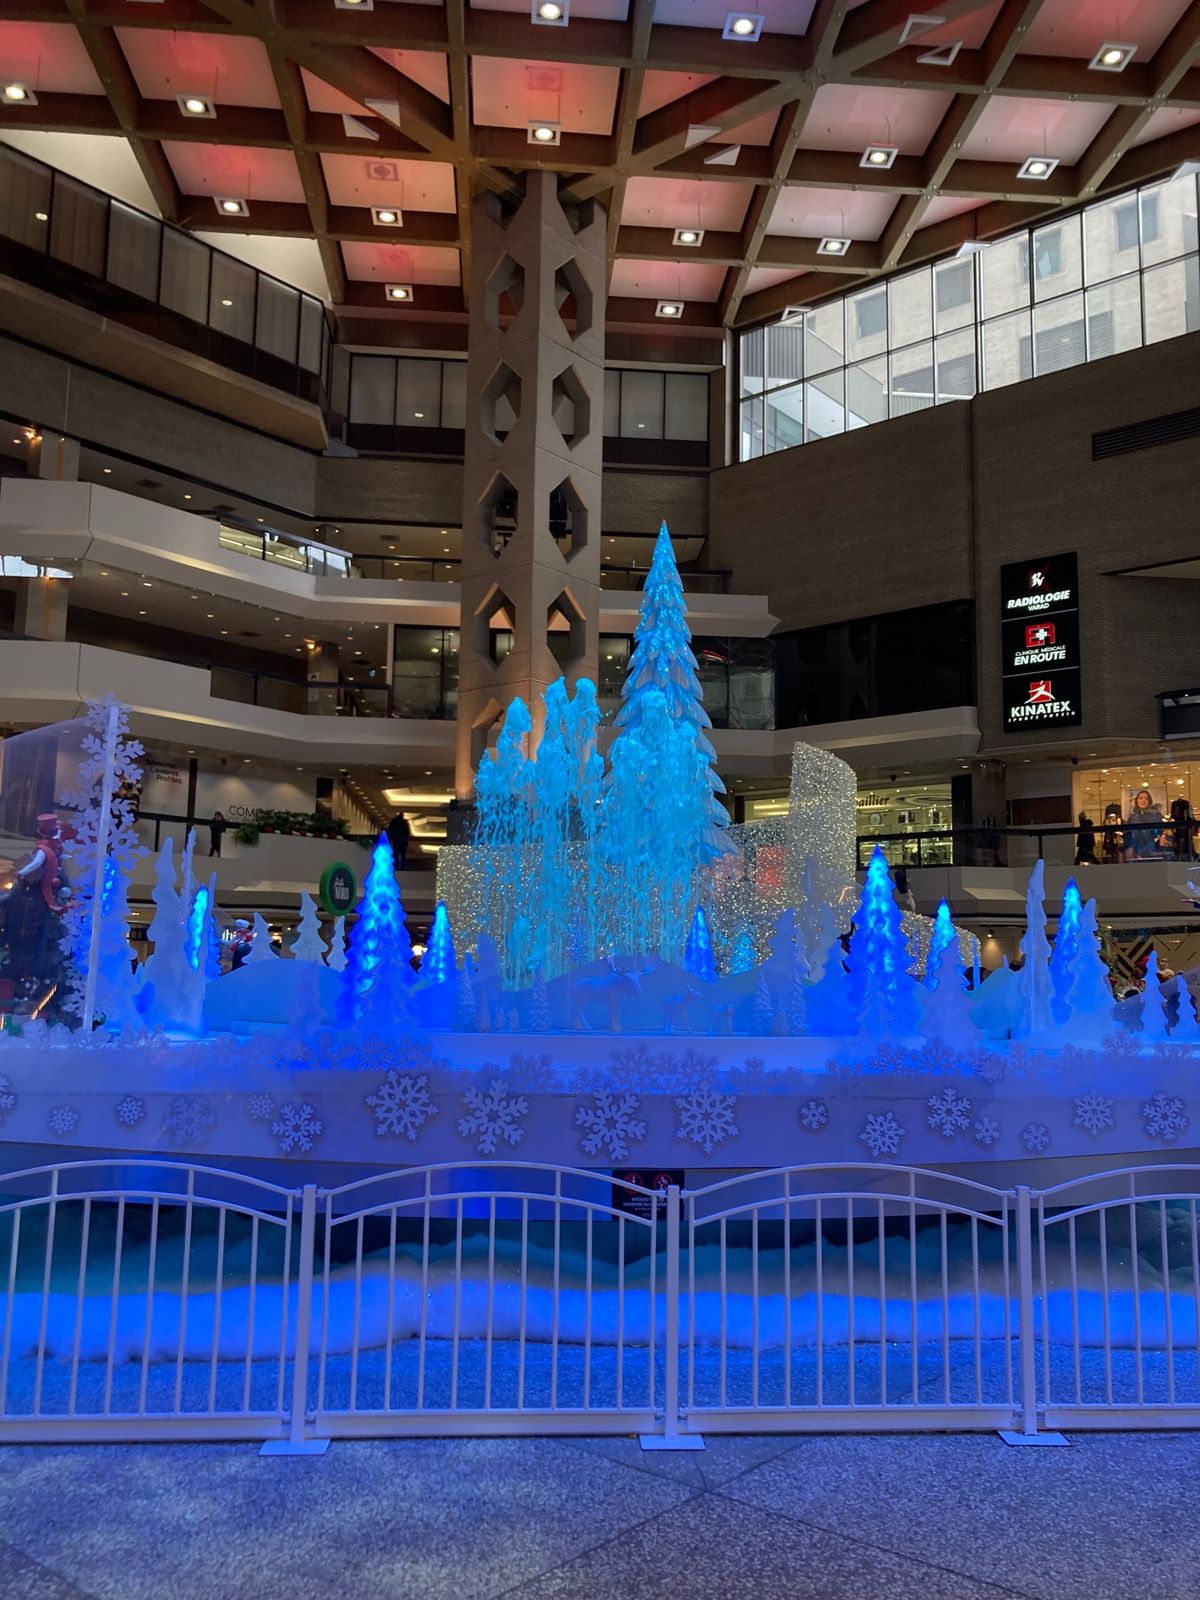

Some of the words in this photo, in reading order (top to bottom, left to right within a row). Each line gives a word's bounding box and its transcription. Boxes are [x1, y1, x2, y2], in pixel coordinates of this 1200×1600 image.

[1007, 590, 1071, 609] RADIOLOGIE
[1014, 655, 1030, 666] EN
[1030, 650, 1067, 664] ROUTE
[1015, 649, 1040, 657] CLINIQUE
[1011, 700, 1071, 718] KINATEX
